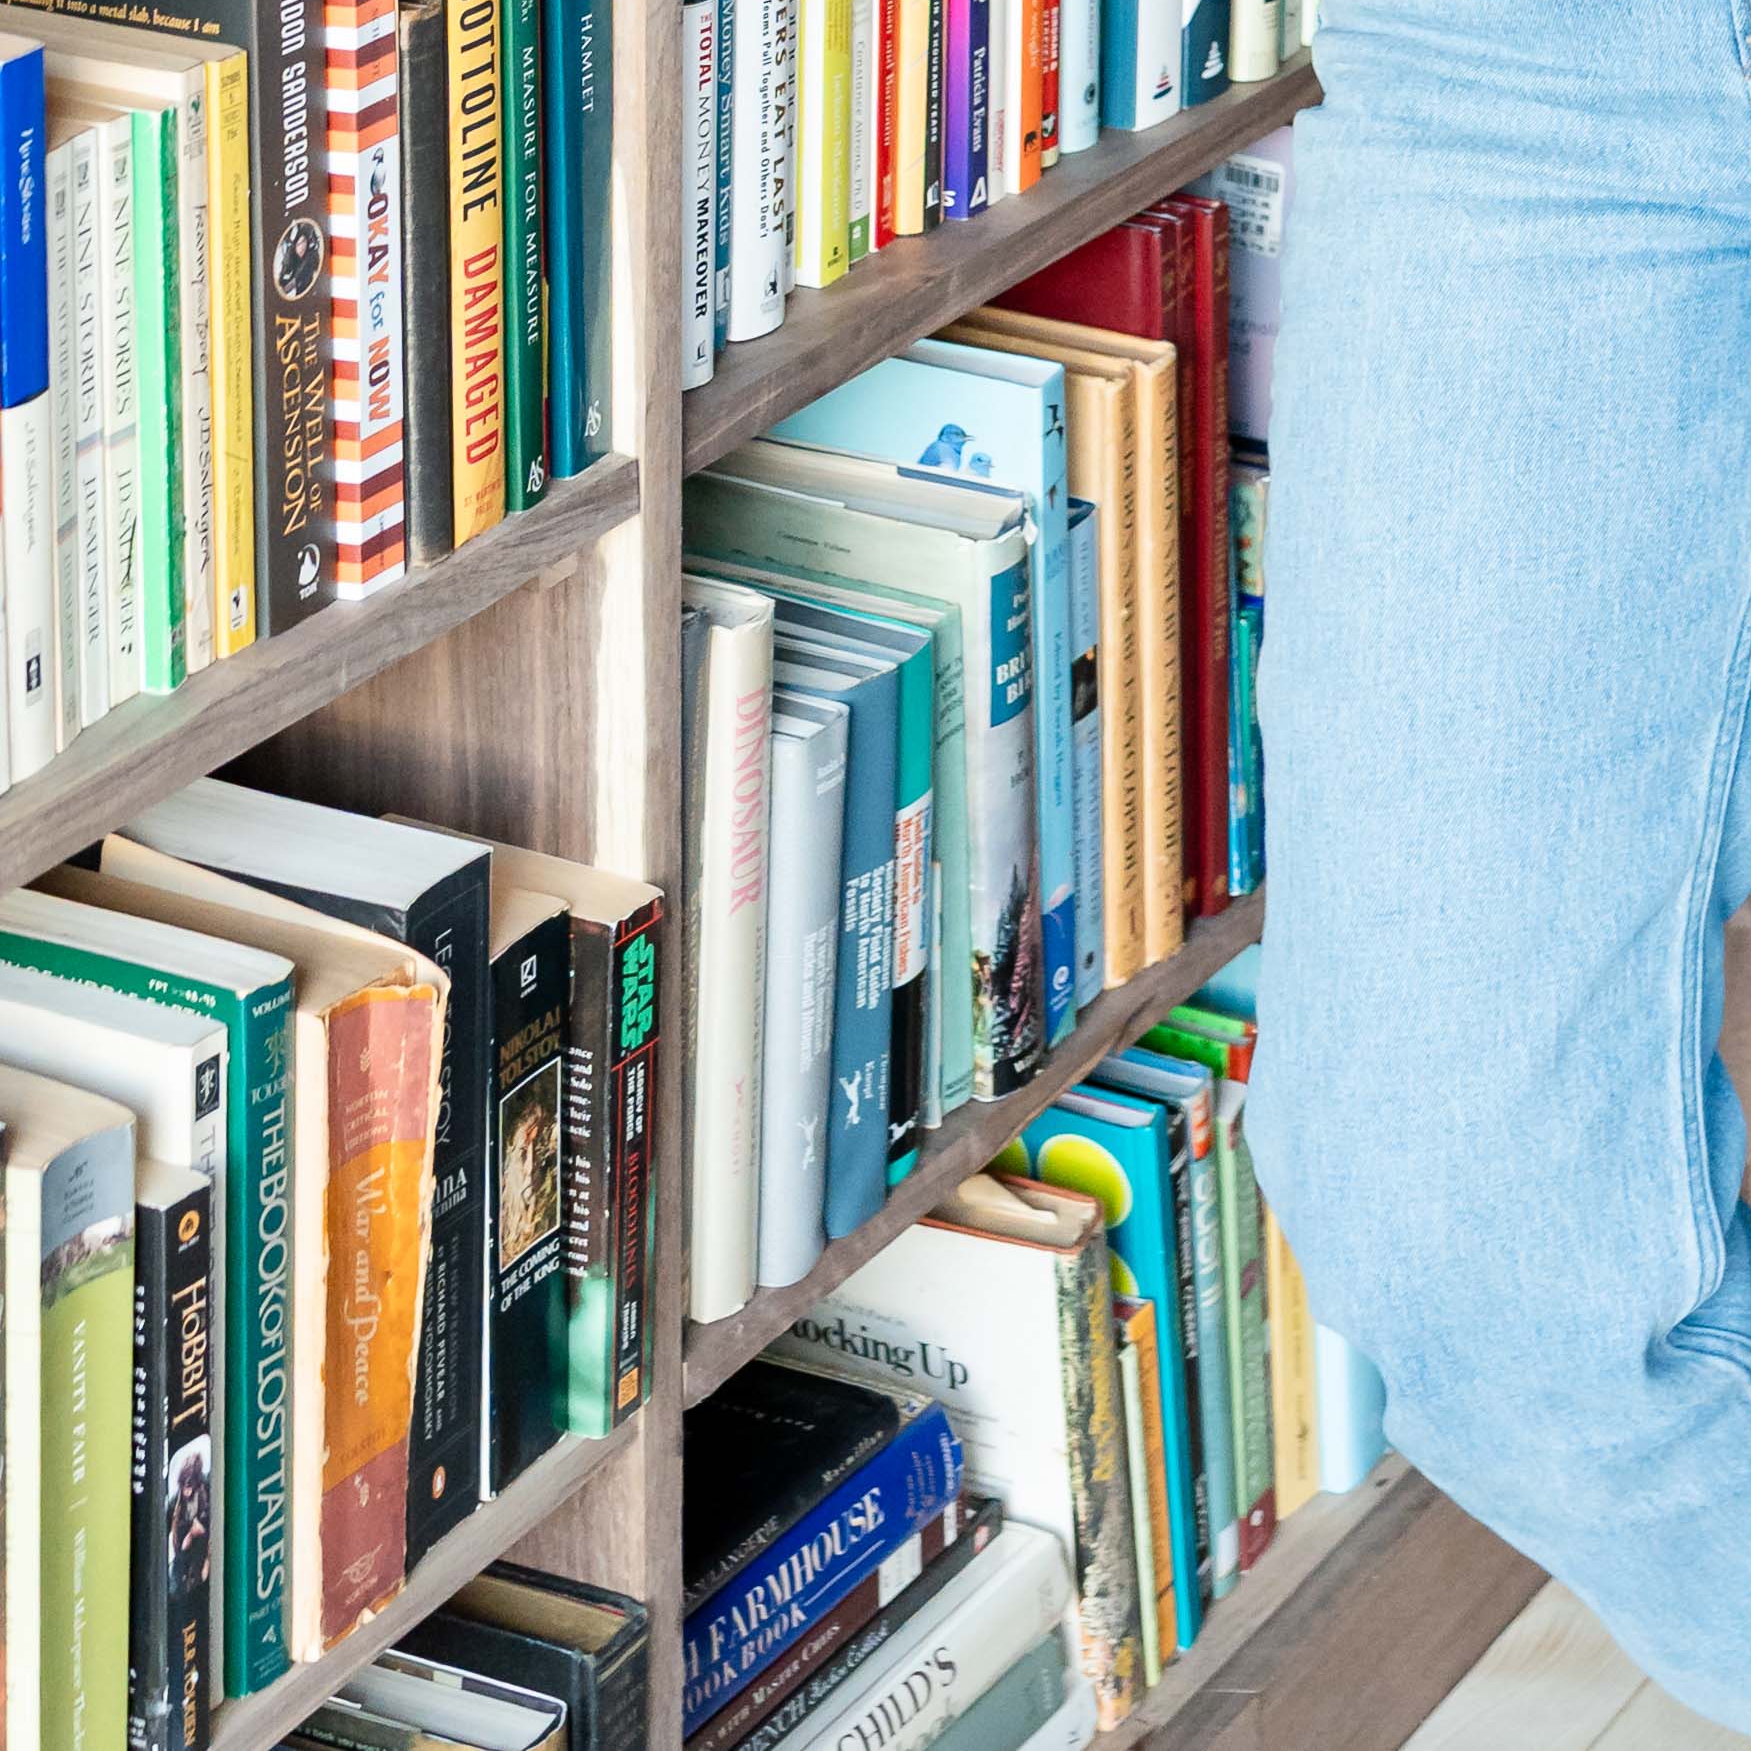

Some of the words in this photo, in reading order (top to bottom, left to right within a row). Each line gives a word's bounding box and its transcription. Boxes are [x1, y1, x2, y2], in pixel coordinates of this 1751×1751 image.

[932, 1, 939, 15] IN
[521, 45, 536, 160] MEASURE
[580, 12, 595, 113] HAMLET
[698, 25, 714, 92] TOTAL
[931, 31, 939, 102] THOUSAND
[281, 60, 310, 214] SANDERSON
[697, 96, 713, 192] MONEY
[772, 81, 788, 141] EAT
[930, 103, 939, 144] YEARS
[523, 170, 537, 225] FOR
[771, 155, 786, 236] LAST
[525, 232, 540, 347] MEASURE
[695, 197, 711, 320] MAKEOVER
[463, 243, 500, 466] DAMAGED
[275, 313, 307, 537] ASCENSION
[729, 686, 767, 916] DINOSAUR
[870, 865, 885, 923] Society
[500, 1005, 561, 1065] NIKOLAI
[621, 936, 642, 1051] WARS
[634, 935, 656, 1045] STAR
[499, 1033, 562, 1087] TOLSTOY
[354, 1167, 386, 1237] War
[626, 1150, 641, 1290] BLOODLINES
[354, 1248, 380, 1303] and
[500, 1269, 519, 1292] THE
[518, 1237, 561, 1282] COMING
[71, 1320, 86, 1414] VANITY
[171, 1275, 208, 1431] HOBBIT
[343, 1294, 381, 1407] Peace
[71, 1421, 86, 1484] FAIR
[708, 1486, 888, 1662] FARMHOUSE
[836, 1644, 959, 1751] CHILD'S
